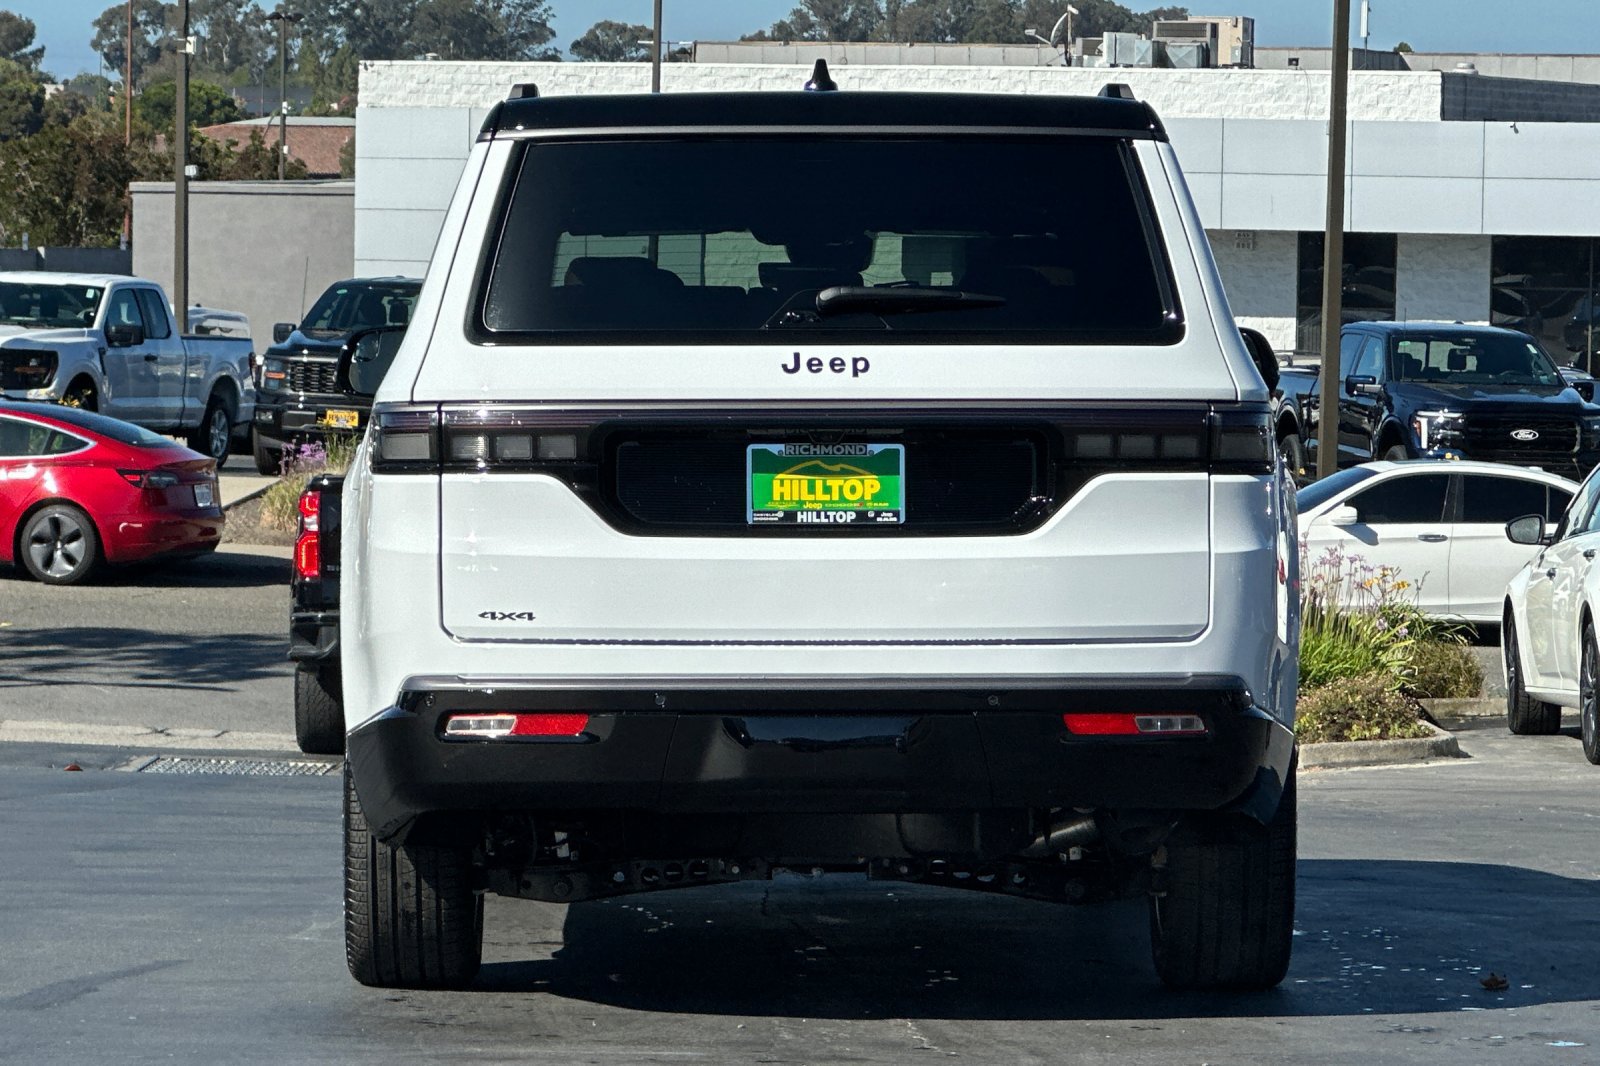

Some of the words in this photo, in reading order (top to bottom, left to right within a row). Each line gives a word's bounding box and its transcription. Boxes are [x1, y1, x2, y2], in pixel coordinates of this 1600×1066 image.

[781, 352, 870, 378] Jeep
[785, 445, 866, 455] RICHMOND
[773, 479, 881, 501] HILLTOP
[803, 501, 823, 510] Jeep
[797, 511, 857, 523] HILLTOP
